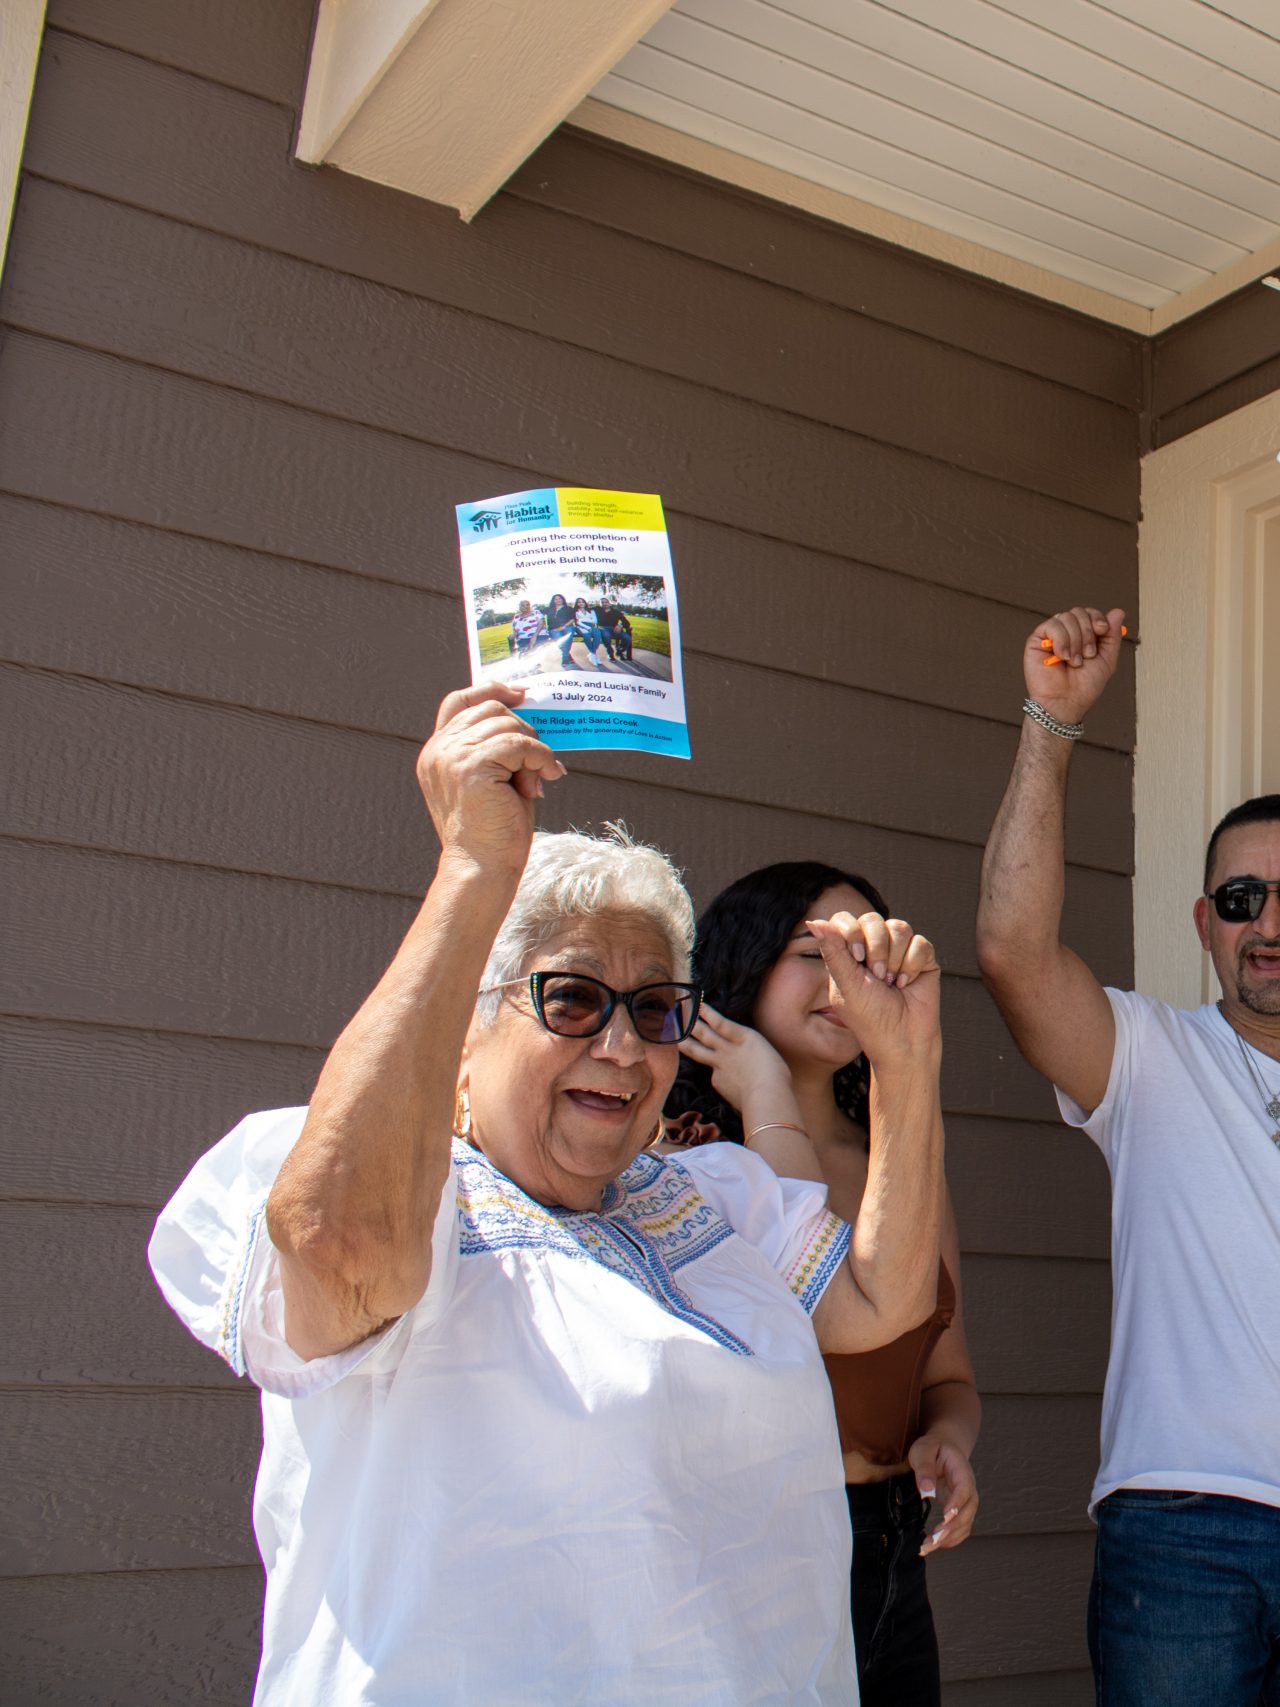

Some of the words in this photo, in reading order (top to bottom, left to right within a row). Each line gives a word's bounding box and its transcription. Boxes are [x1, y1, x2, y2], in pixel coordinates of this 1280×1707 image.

[505, 505, 550, 519] Habitat
[570, 534, 626, 542] completion
[515, 544, 582, 556] construction
[515, 558, 556, 568] Maverik
[588, 556, 618, 564] home
[558, 680, 582, 688] Alex,
[604, 682, 636, 692] Lucia's
[638, 686, 666, 698] Family
[565, 692, 585, 702] July
[588, 694, 612, 702] 2024
[531, 716, 548, 724] The
[550, 717, 576, 726] Ridge
[612, 718, 638, 726] Creek
